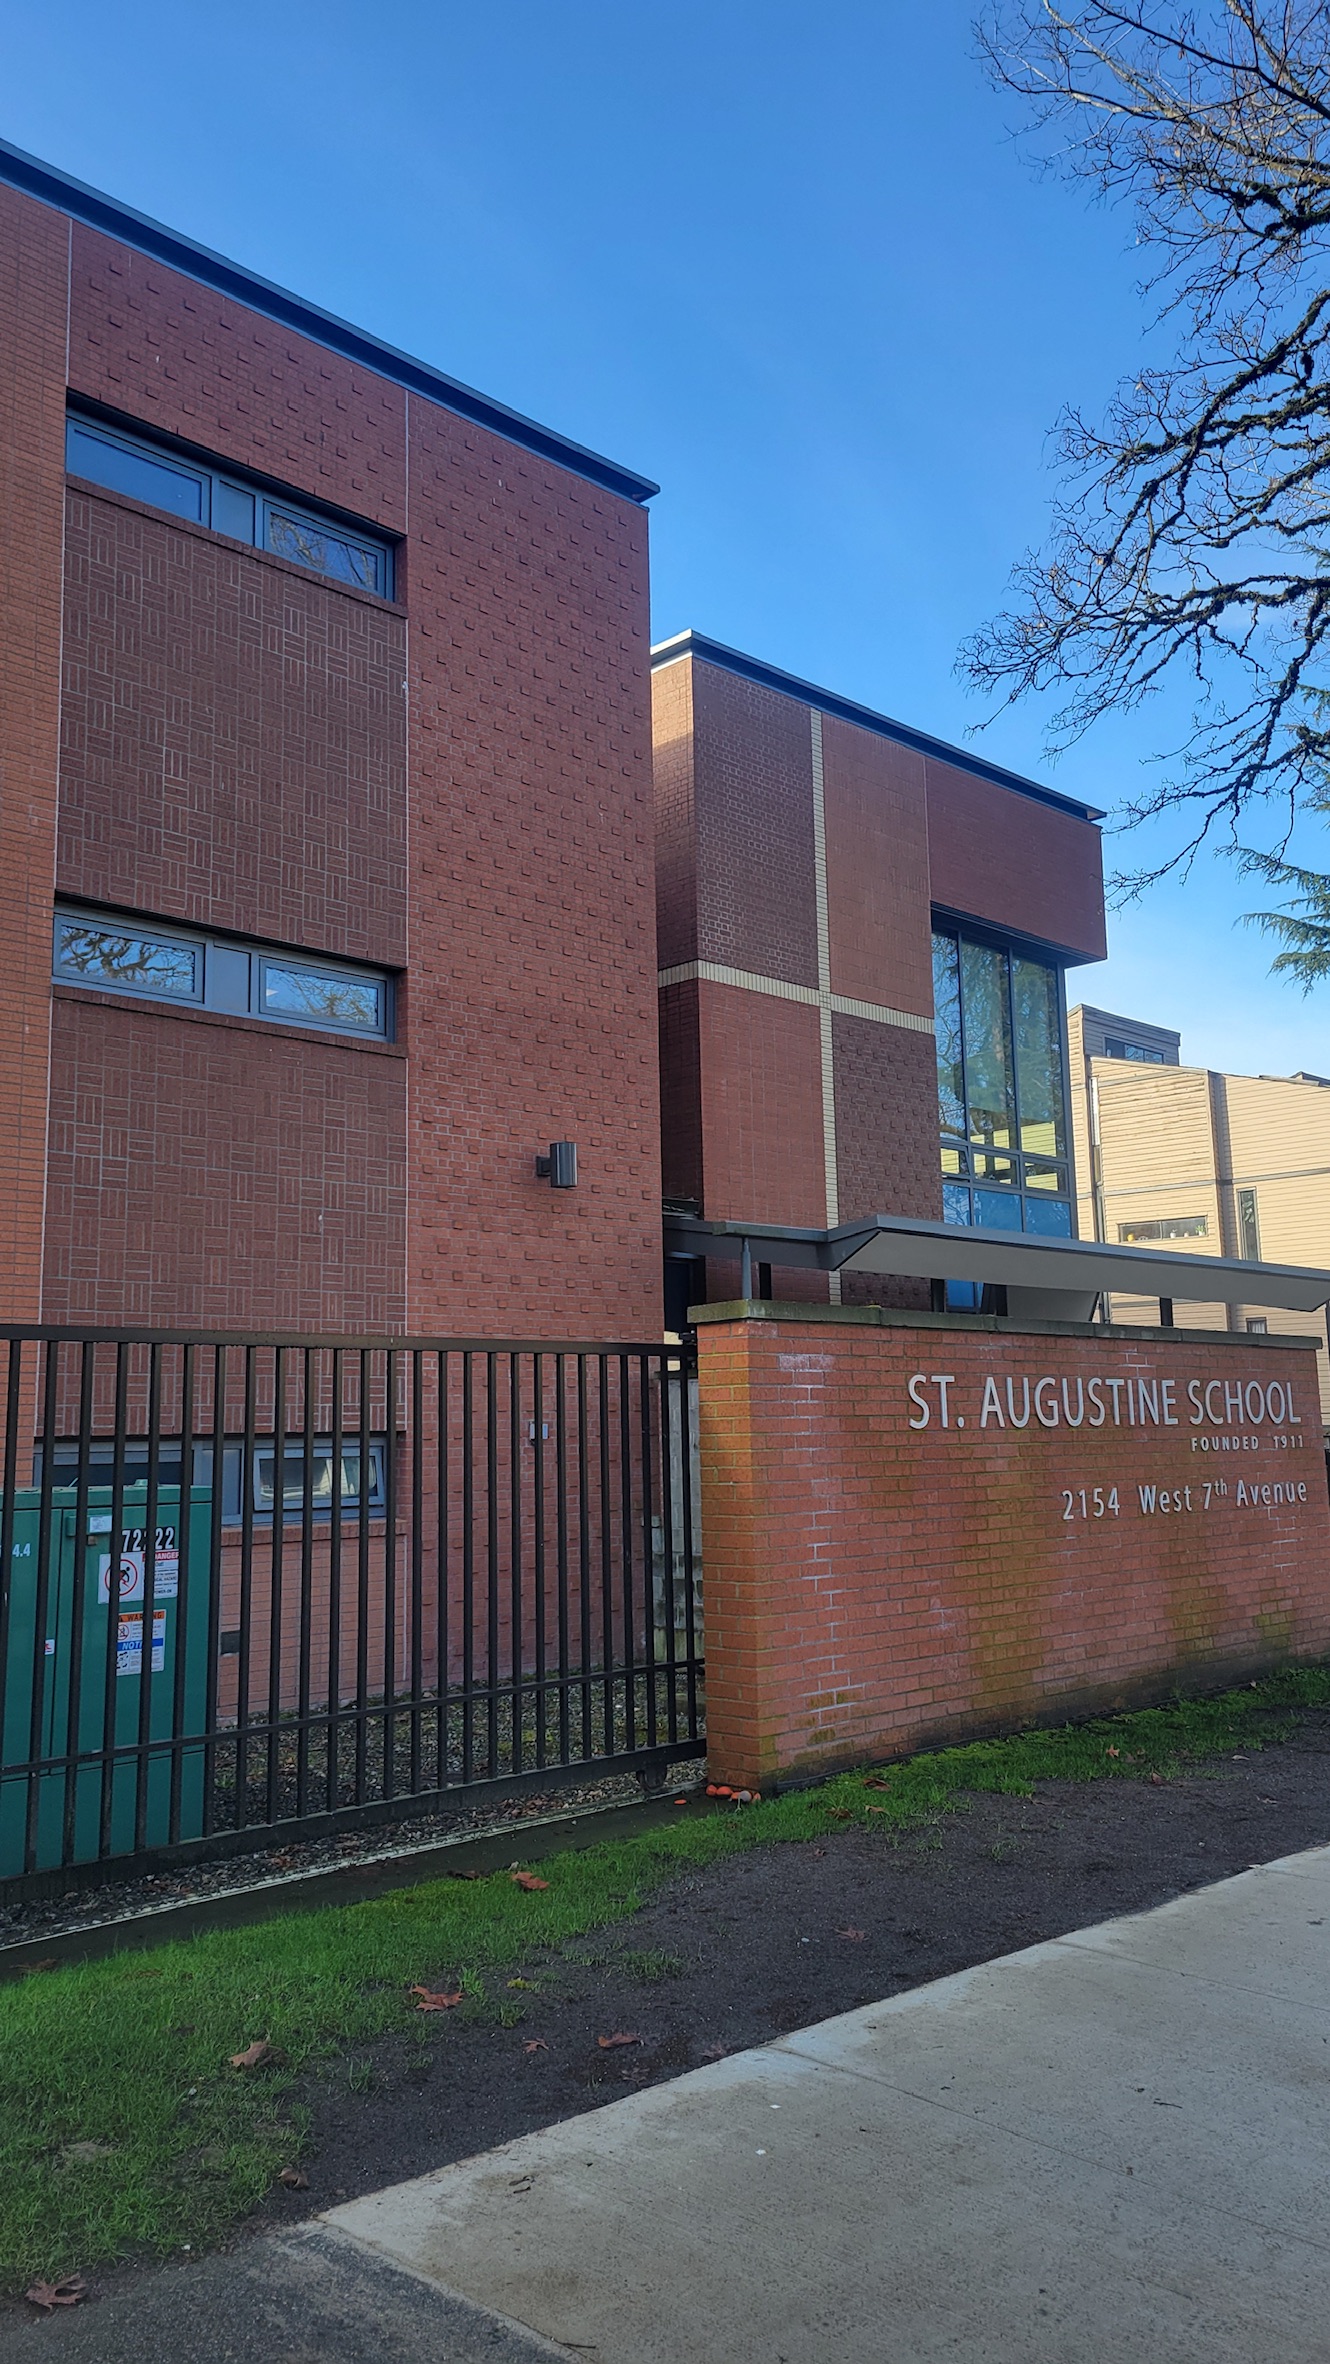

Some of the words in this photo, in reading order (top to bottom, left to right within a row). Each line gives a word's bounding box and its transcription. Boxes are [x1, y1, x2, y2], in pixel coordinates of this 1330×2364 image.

[908, 1374, 965, 1430] ST.
[980, 1376, 1179, 1429] AUGUSTINE
[1187, 1379, 1302, 1426] SCHOOL
[1191, 1436, 1259, 1452] FOUNDED
[1273, 1434, 1303, 1449] 1911
[1062, 1487, 1120, 1520] 2154
[1138, 1484, 1193, 1514] West
[1202, 1478, 1228, 1511] 7th
[1236, 1479, 1308, 1508] Avenue
[12, 1543, 31, 1557] 4.4
